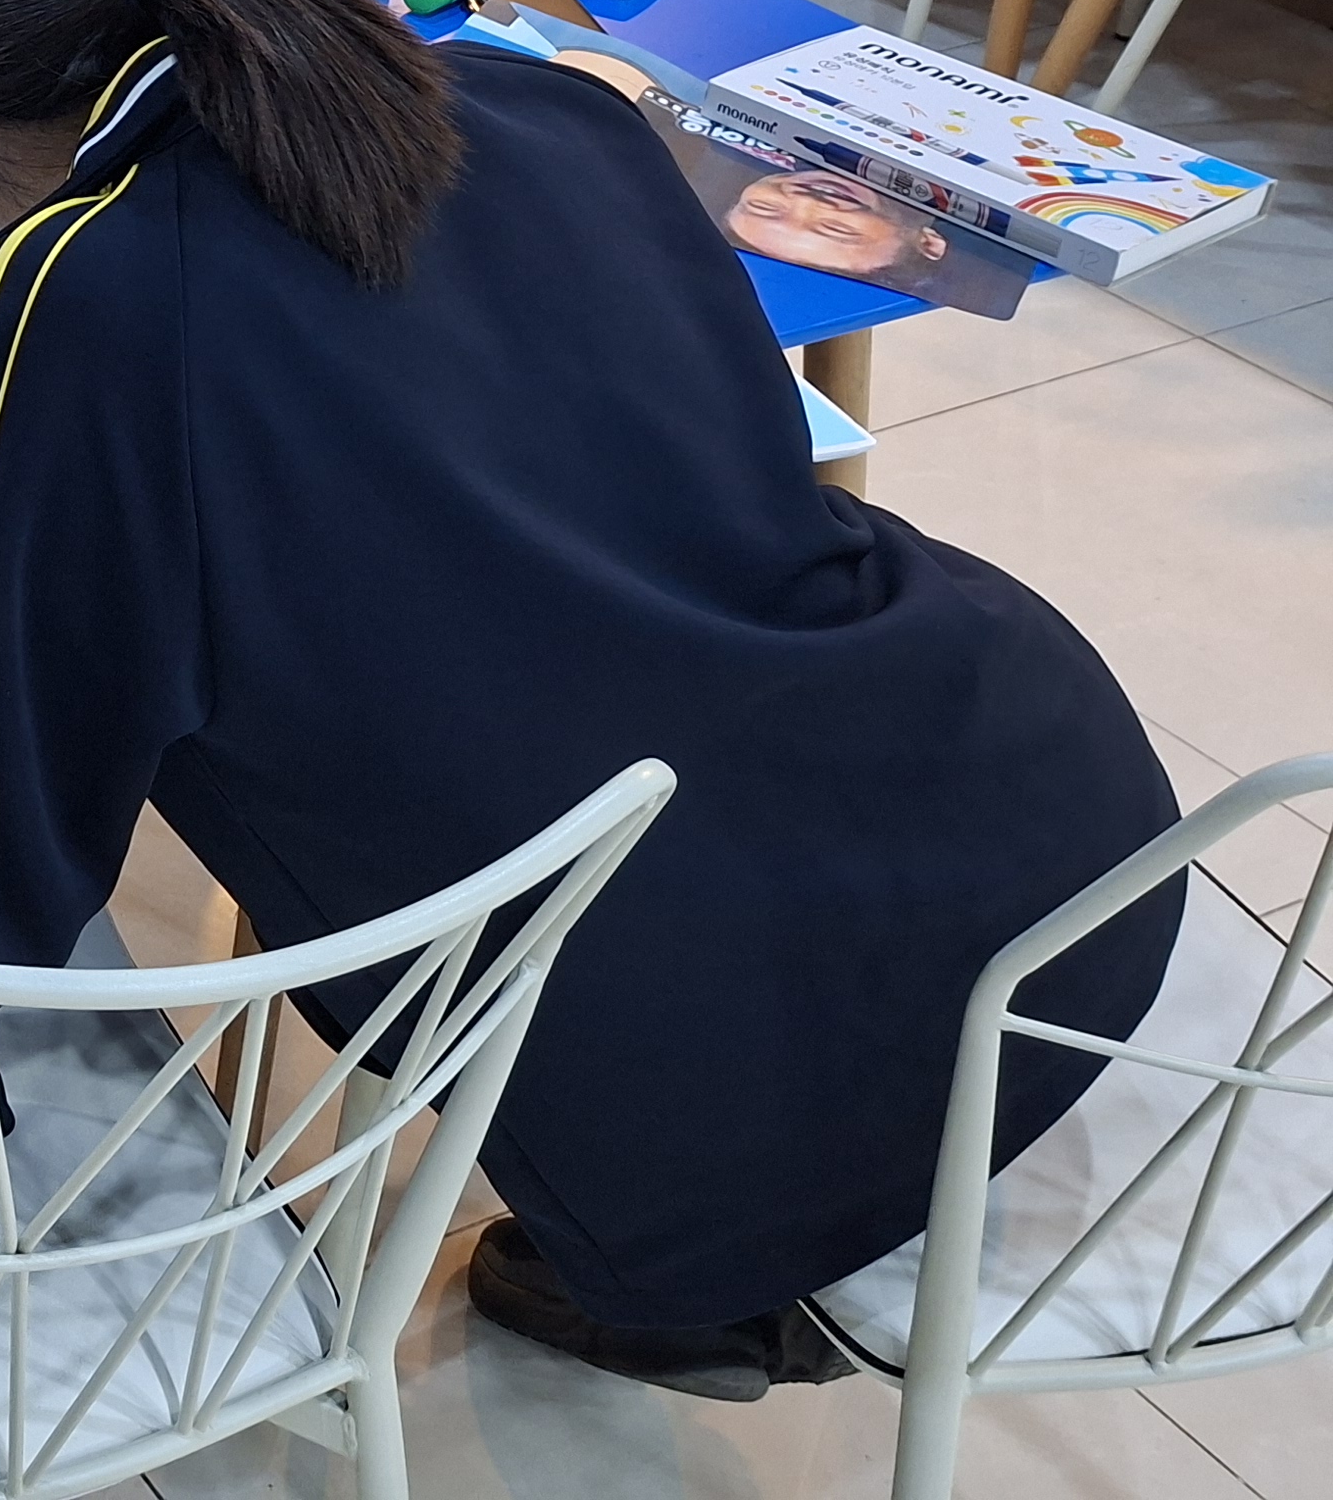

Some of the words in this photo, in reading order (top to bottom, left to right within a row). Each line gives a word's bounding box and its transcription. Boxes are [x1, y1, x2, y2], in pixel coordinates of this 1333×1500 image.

[858, 43, 1030, 105] monami
[717, 102, 778, 134] monami
[1076, 251, 1102, 273] 12
